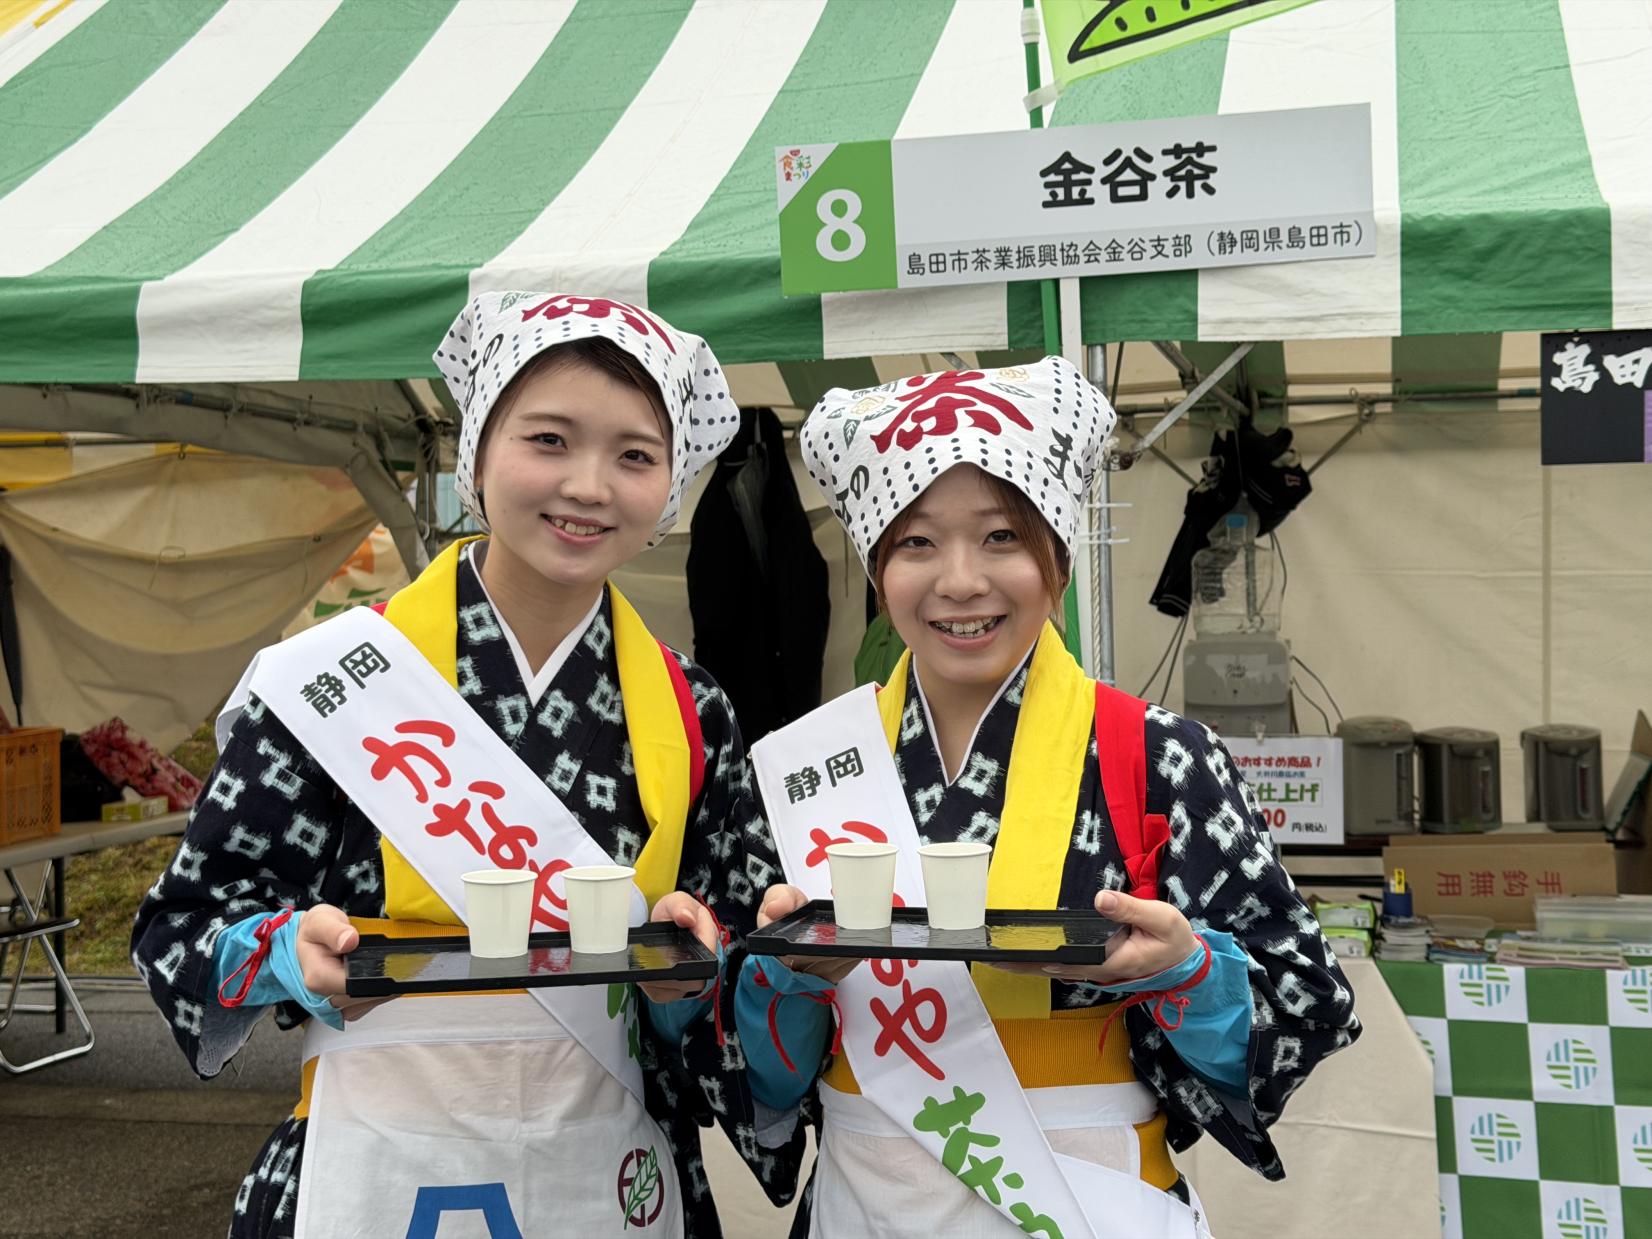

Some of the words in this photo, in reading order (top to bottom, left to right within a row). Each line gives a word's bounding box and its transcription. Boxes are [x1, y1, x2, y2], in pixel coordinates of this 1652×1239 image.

[1039, 140, 1219, 209] 金谷茶
[816, 188, 867, 262] 8
[1550, 341, 1652, 393] 島田
[299, 641, 392, 718] 静岡
[784, 746, 865, 805] 静岡
[1247, 782, 1320, 803] 仕上げ
